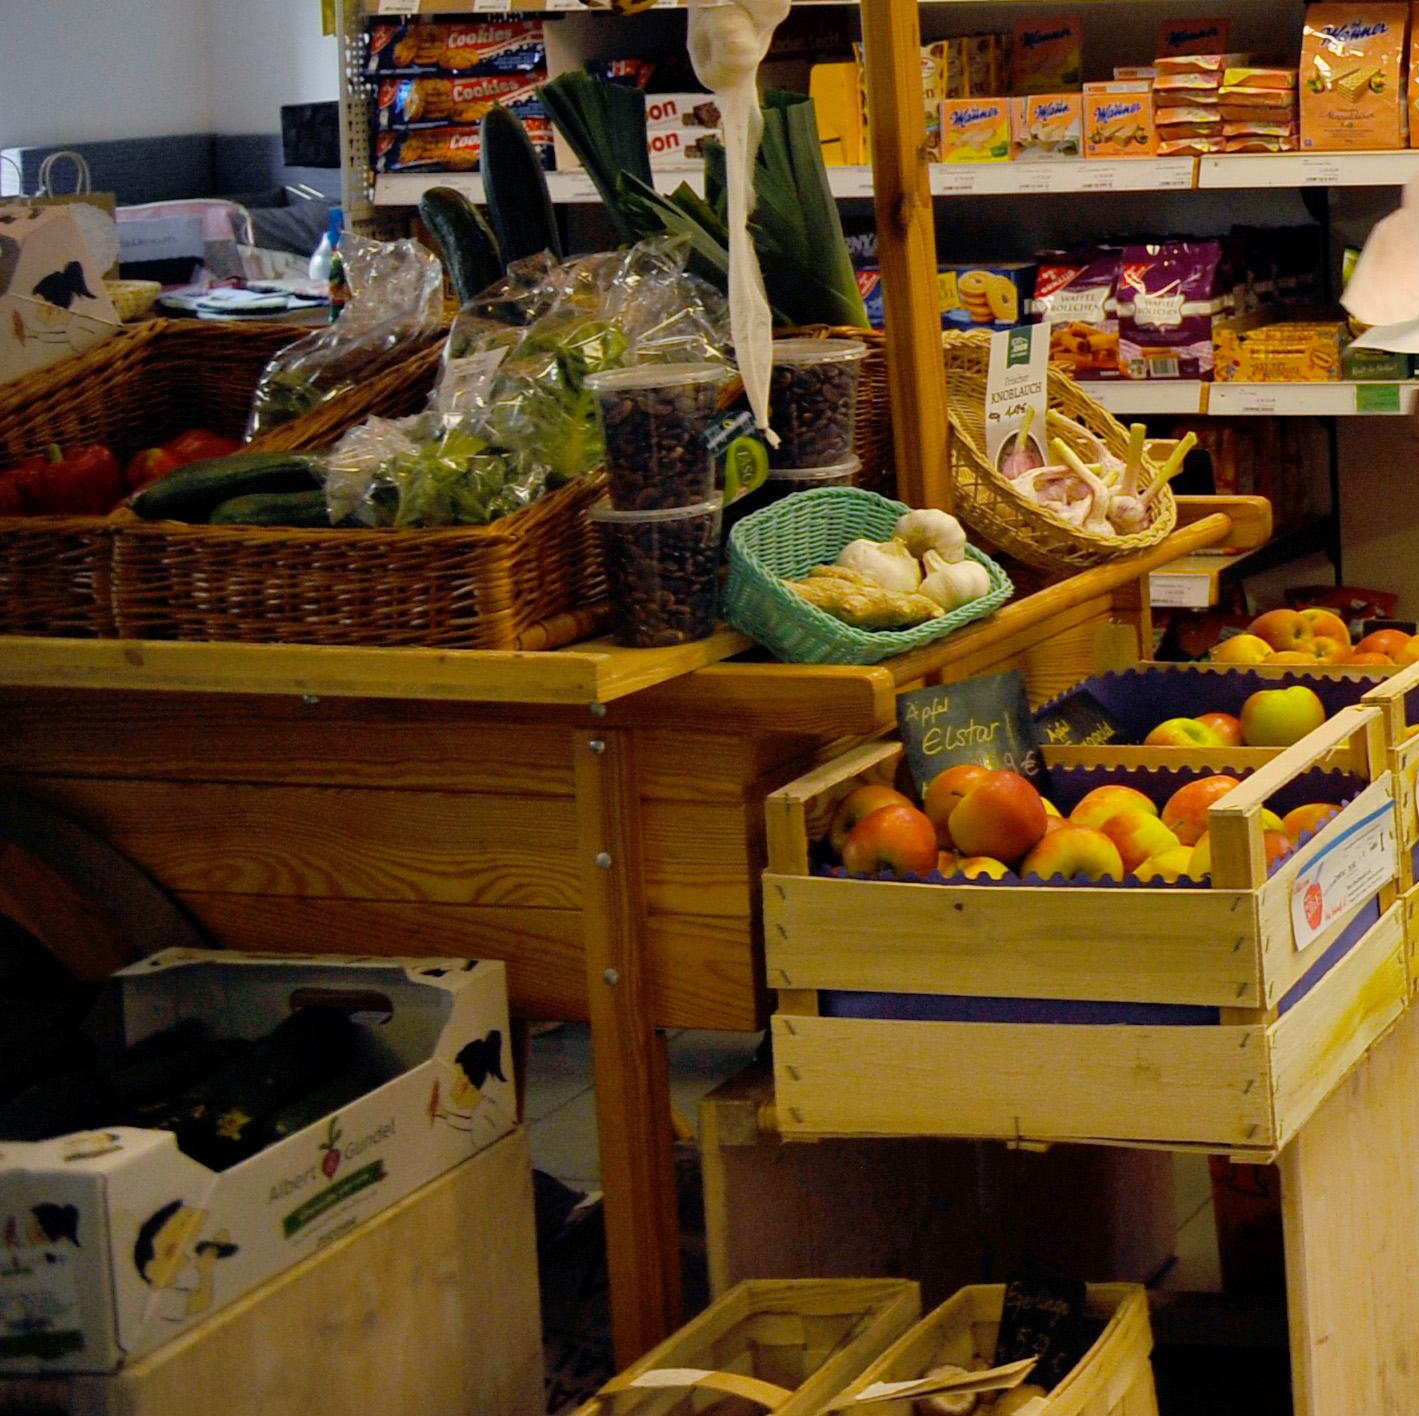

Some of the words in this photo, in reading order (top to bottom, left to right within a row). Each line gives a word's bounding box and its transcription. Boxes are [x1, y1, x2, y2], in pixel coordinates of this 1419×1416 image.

[448, 27, 513, 49] Cookies
[453, 78, 519, 102] Cookies
[1094, 101, 1142, 124] Manner
[992, 381, 1042, 404] KNOBLAUCH
[906, 696, 948, 727] Äpfel
[922, 719, 999, 755] Elstar
